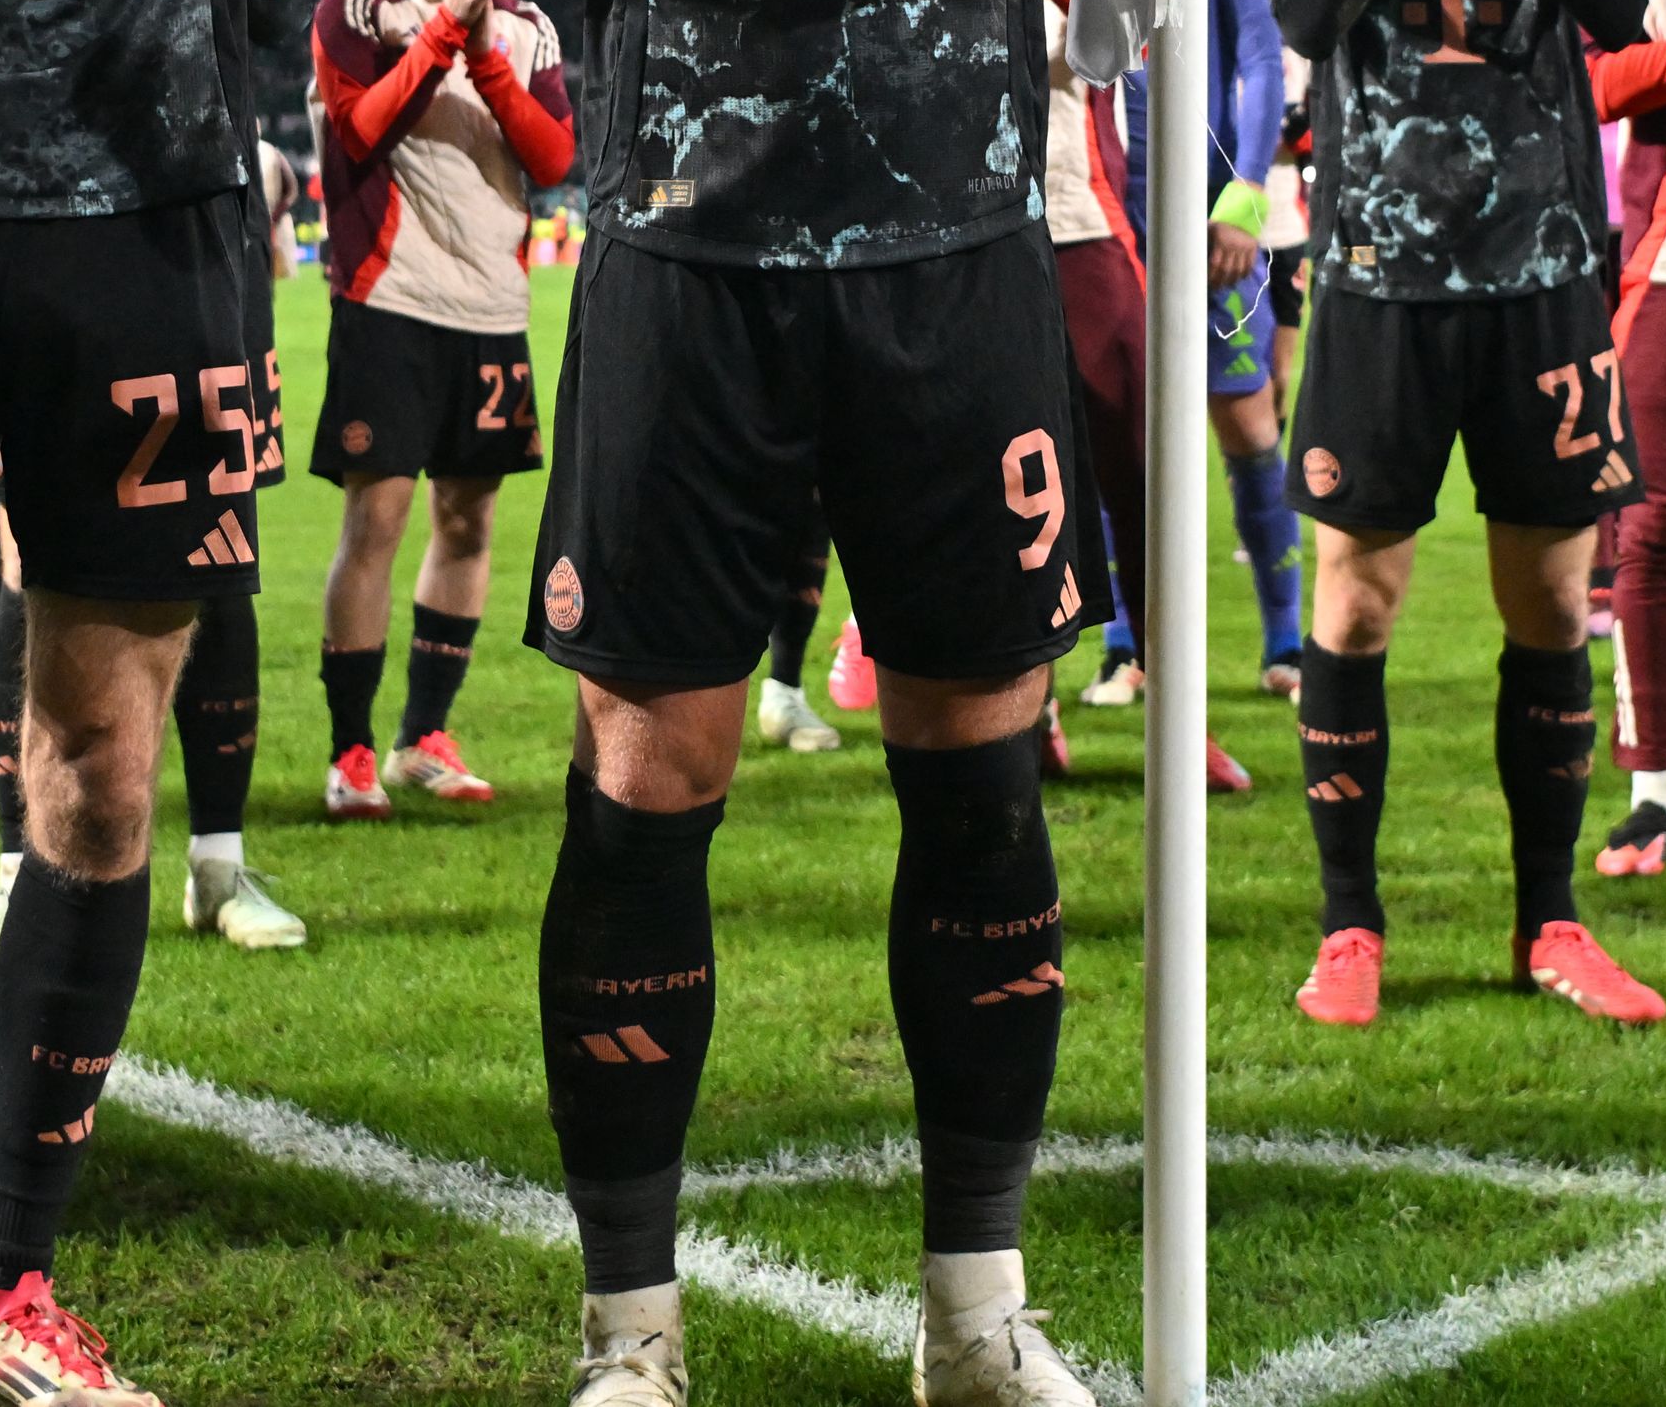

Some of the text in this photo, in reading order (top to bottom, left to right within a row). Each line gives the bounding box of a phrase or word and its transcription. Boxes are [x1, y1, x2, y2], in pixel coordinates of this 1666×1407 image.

[967, 174, 1017, 194] HEAT.RDY
[475, 363, 537, 431] 22
[1536, 348, 1625, 460] 27
[110, 364, 255, 509] 25
[1001, 428, 1065, 571] 9
[932, 916, 973, 937] FC
[31, 1044, 67, 1070] FC
